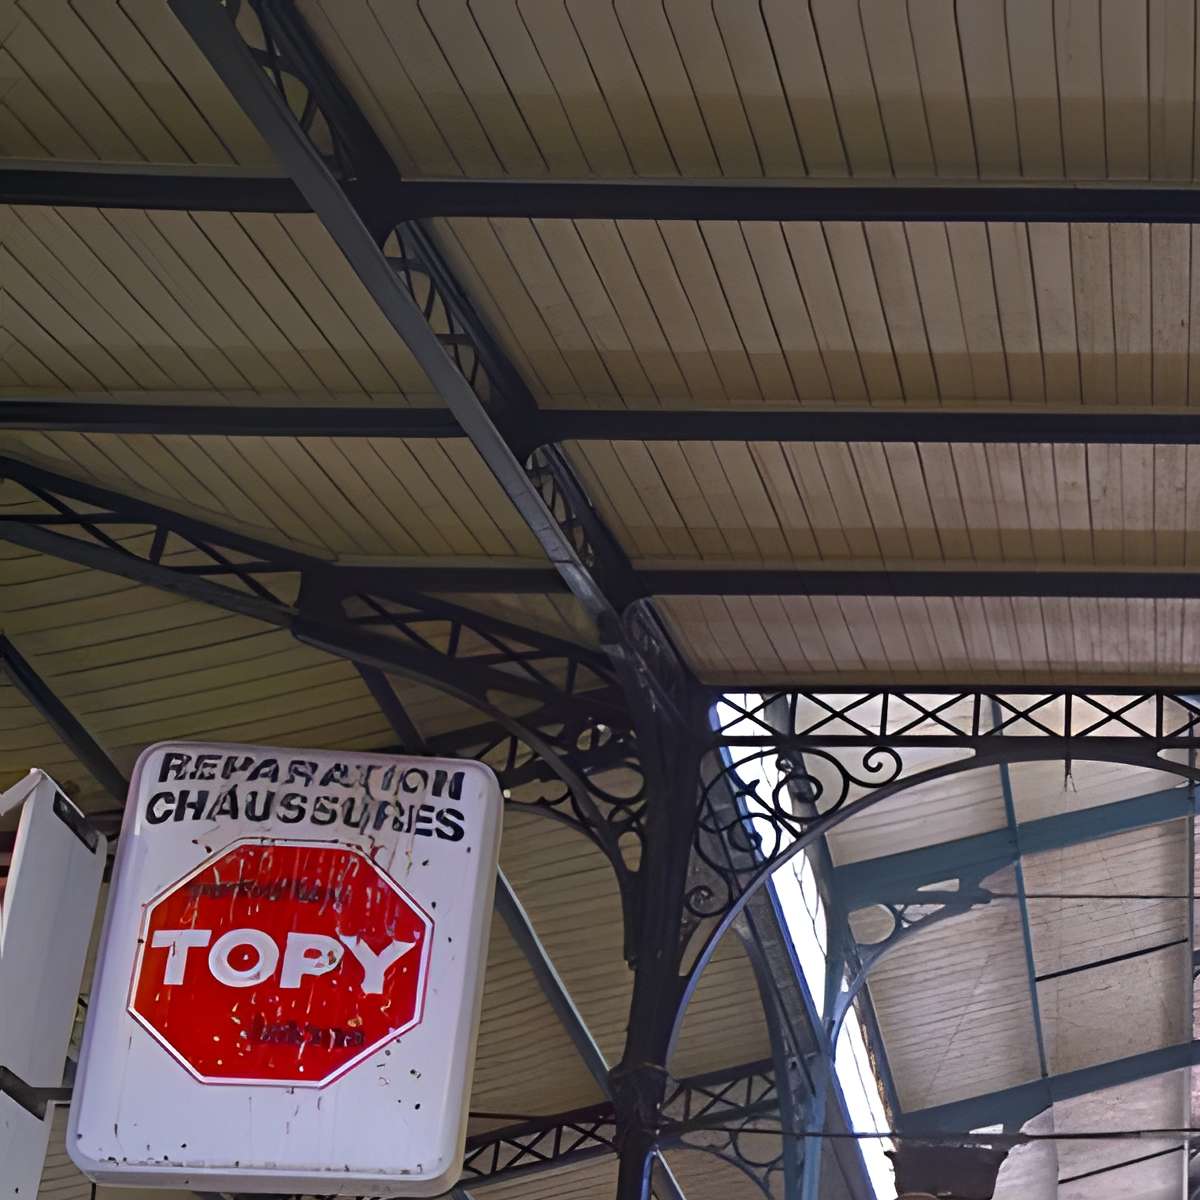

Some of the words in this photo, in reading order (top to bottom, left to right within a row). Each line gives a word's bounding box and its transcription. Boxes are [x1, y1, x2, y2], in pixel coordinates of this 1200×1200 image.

[158, 752, 466, 800] REPARATION
[146, 785, 466, 842] CHAUSSURES
[151, 928, 416, 995] TOPY
